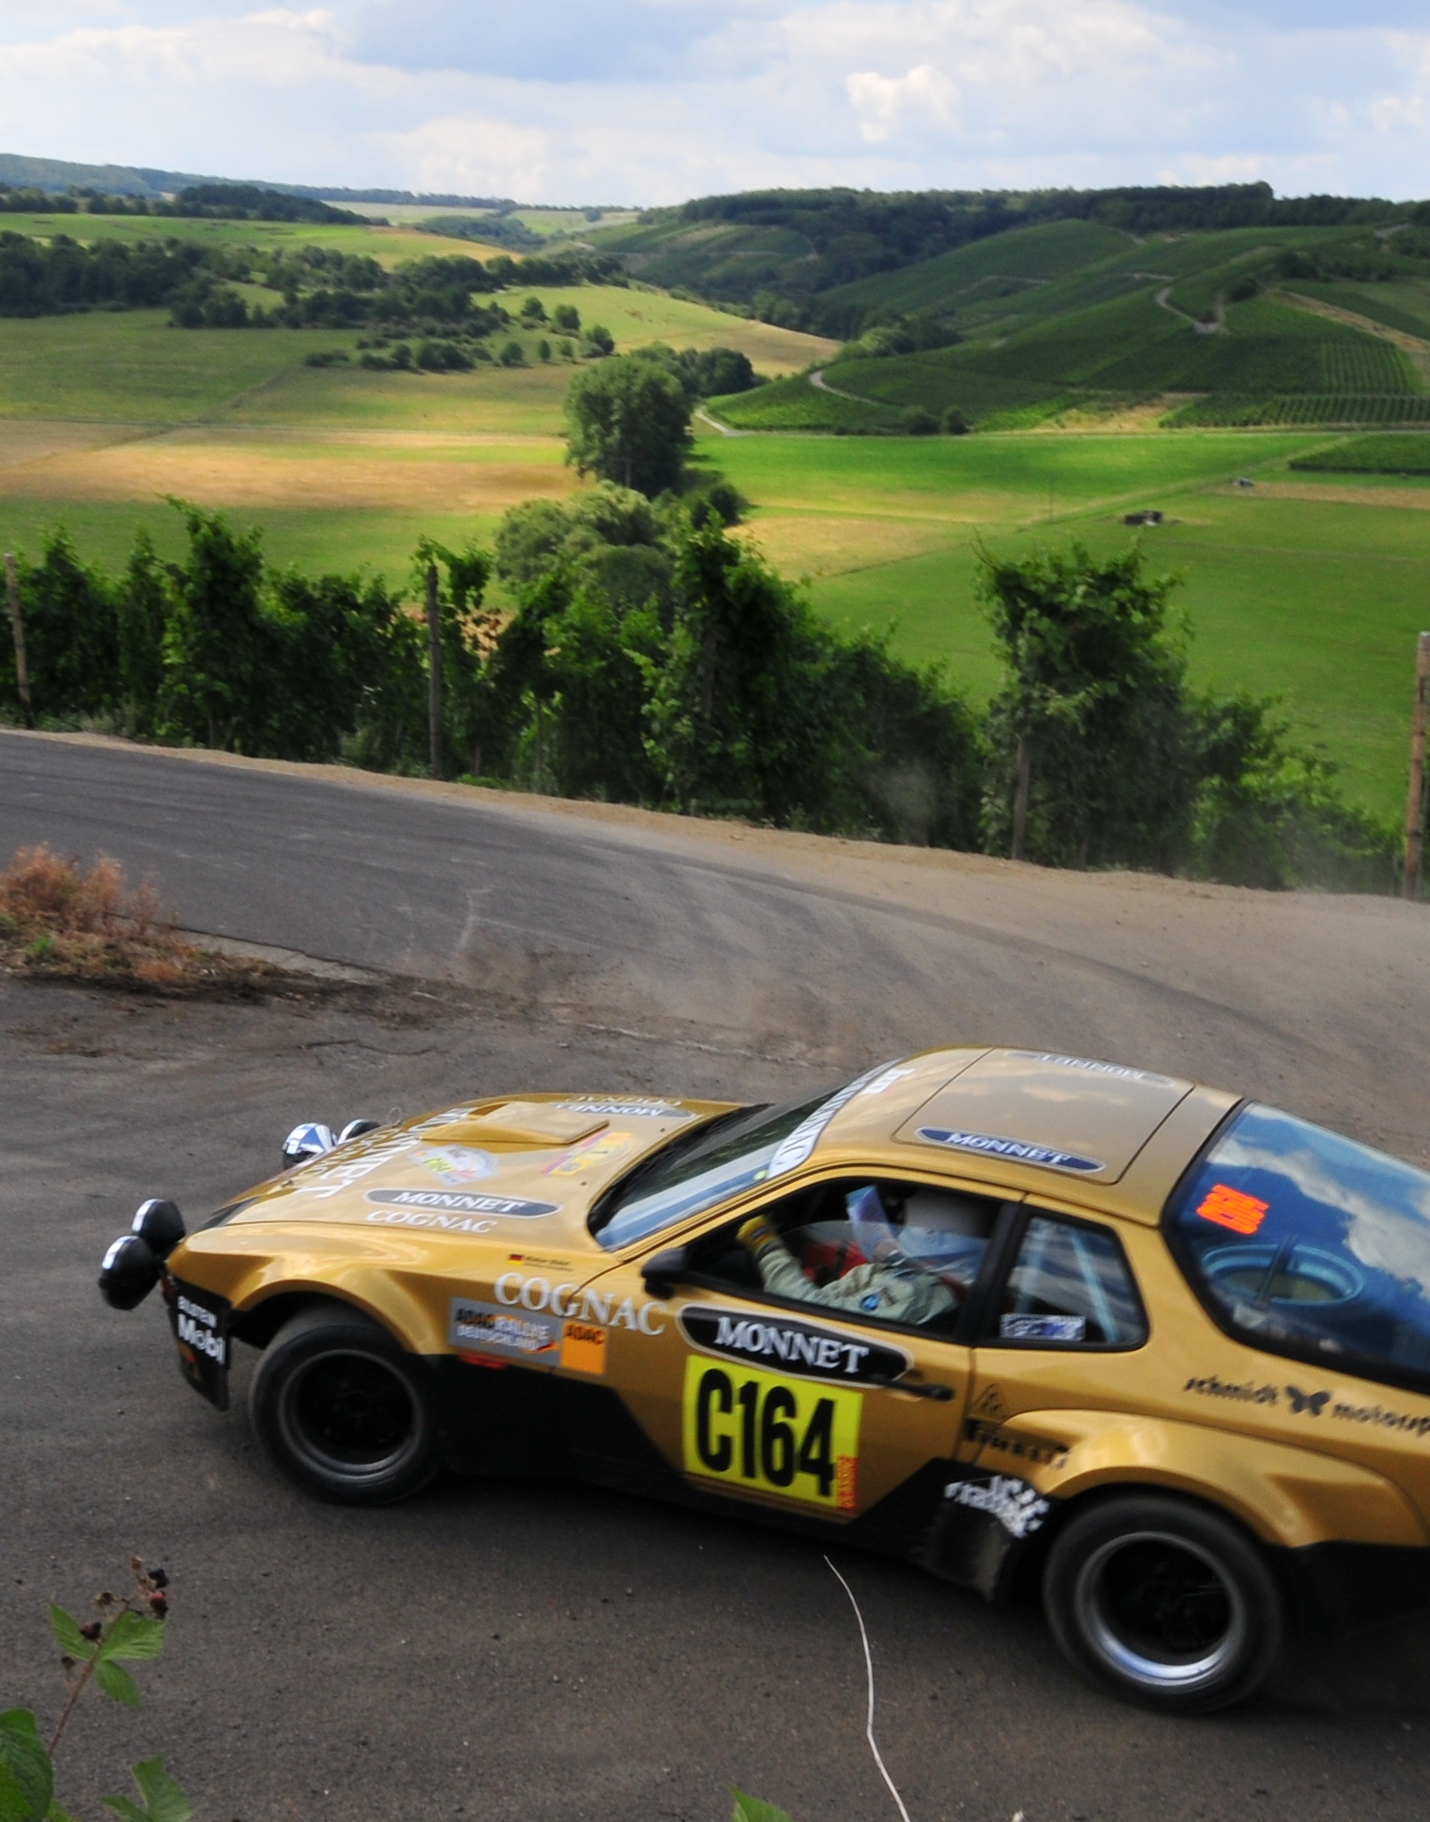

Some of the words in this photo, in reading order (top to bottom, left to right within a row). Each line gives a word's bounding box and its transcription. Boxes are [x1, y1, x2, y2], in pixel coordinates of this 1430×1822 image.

[944, 1131, 1073, 1165] MONNET
[391, 1191, 528, 1213] MONNET
[366, 1209, 498, 1234] COGNAC
[493, 1271, 670, 1337] COGNAC
[713, 1316, 870, 1374] MONNET
[1183, 1374, 1278, 1407] schmidt
[696, 1367, 837, 1498] C164
